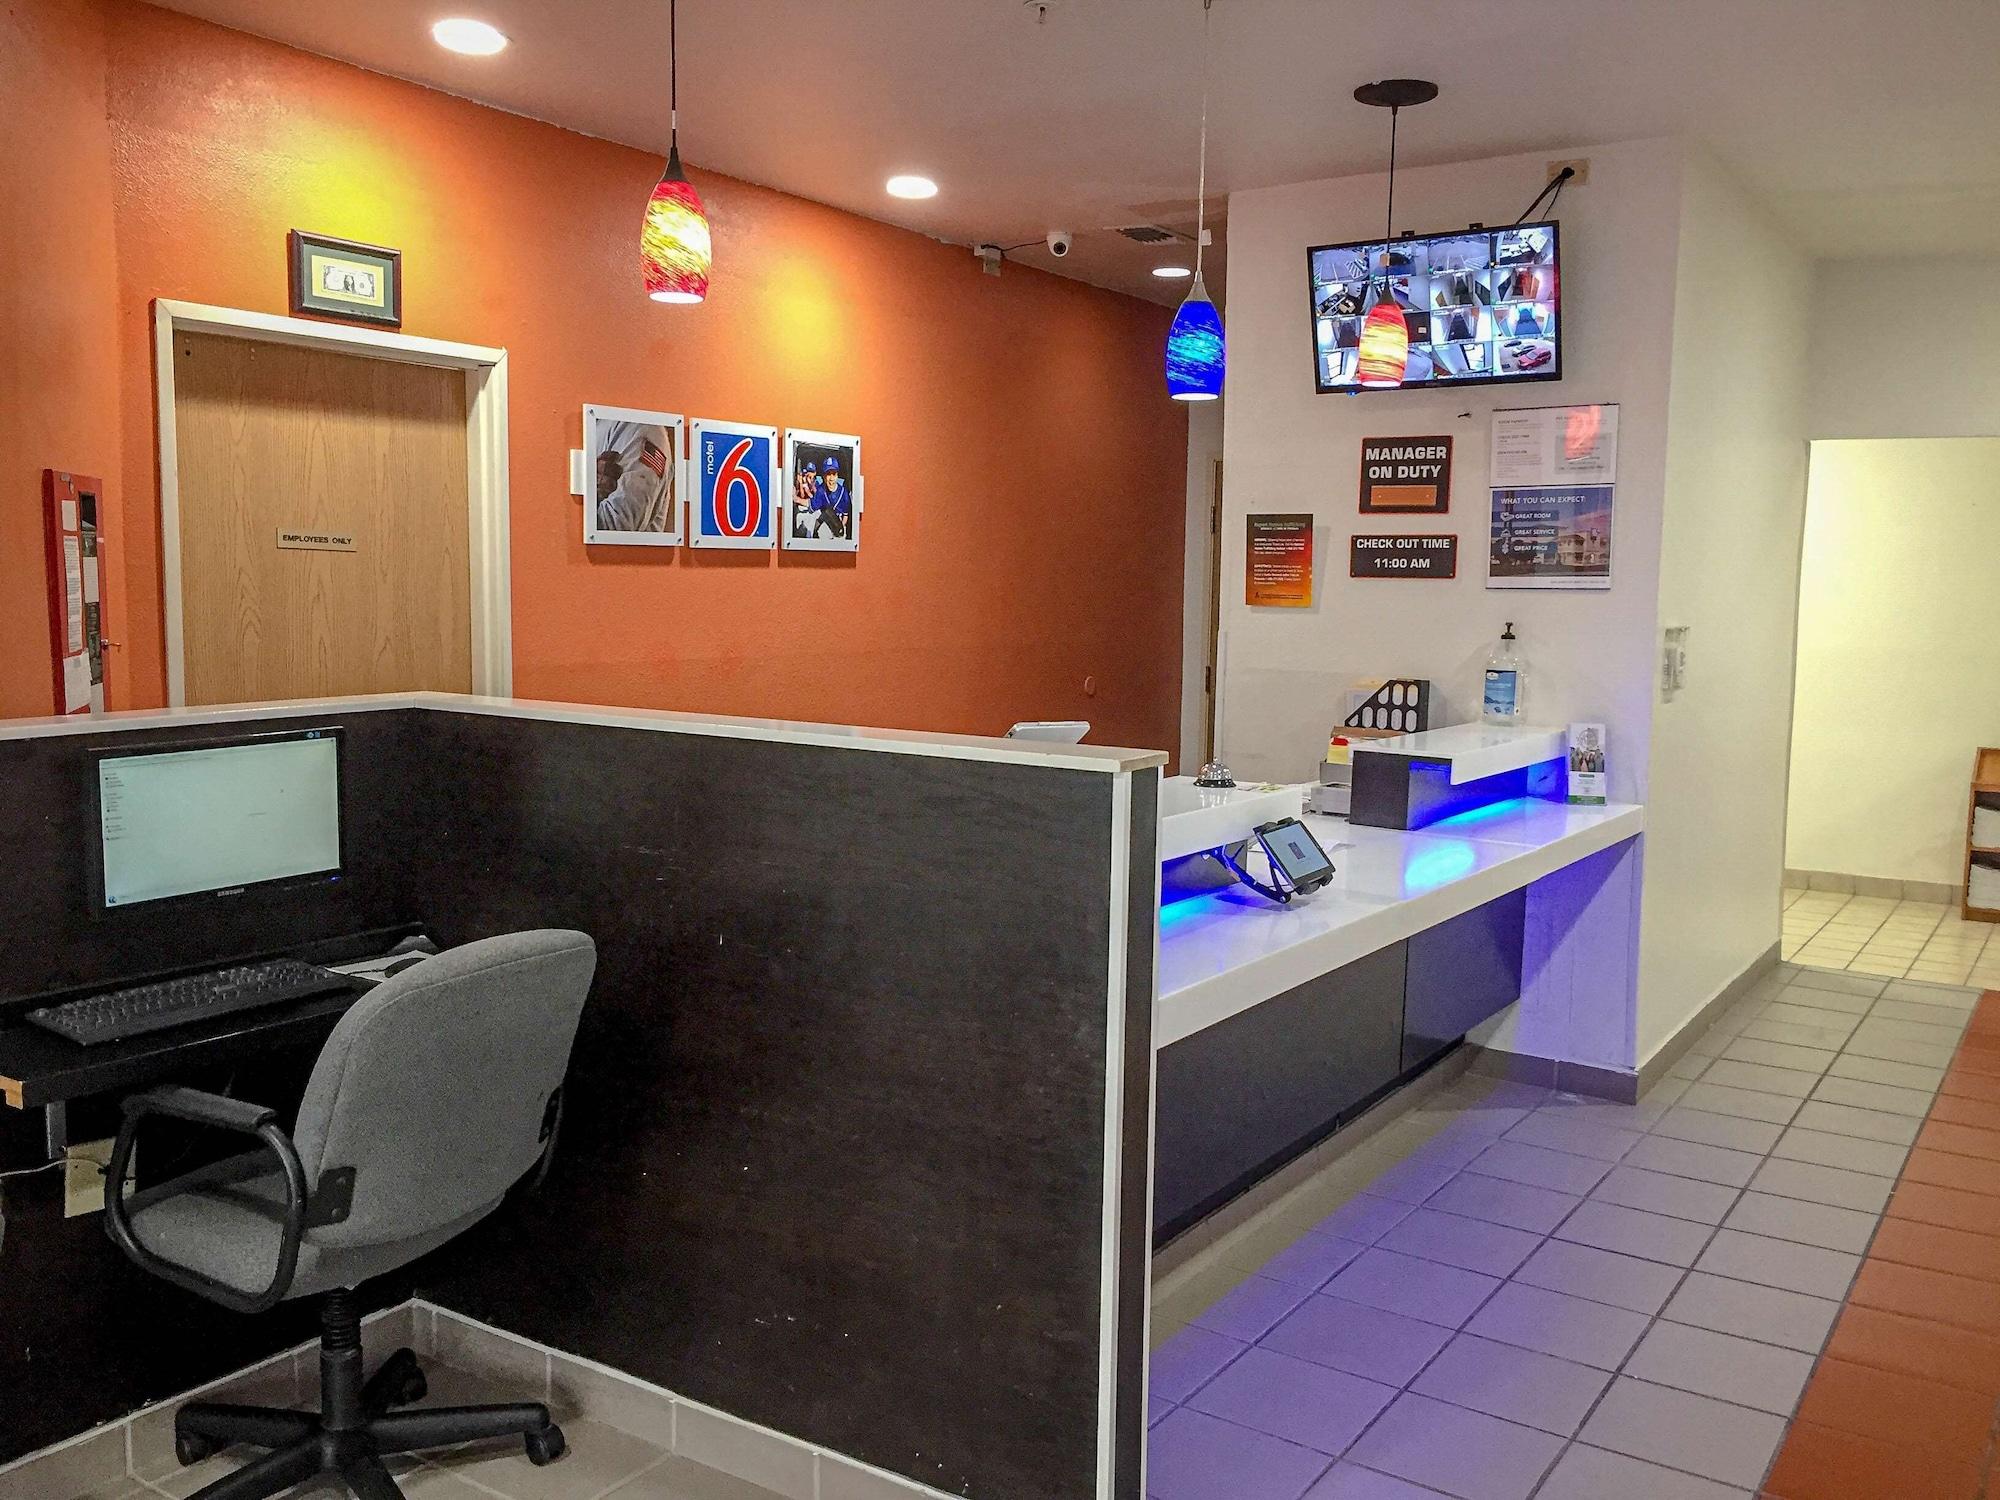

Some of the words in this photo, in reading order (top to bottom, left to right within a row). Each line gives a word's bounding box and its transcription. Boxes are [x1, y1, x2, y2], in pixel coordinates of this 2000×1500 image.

[706, 441, 714, 475] motel
[1365, 446, 1447, 460] MANAGER
[1368, 466, 1392, 478] ON
[1397, 465, 1441, 478] DUTY
[713, 437, 762, 537] 6
[1501, 497, 1521, 505] WHAT
[1540, 496, 1556, 504] CAN
[282, 534, 329, 543] EMPLOYEES
[1356, 538, 1394, 549] CHECK
[1396, 538, 1420, 549] OUT
[1421, 538, 1450, 549] TIME
[1374, 558, 1408, 569] 11:00
[1410, 558, 1431, 569] AM
